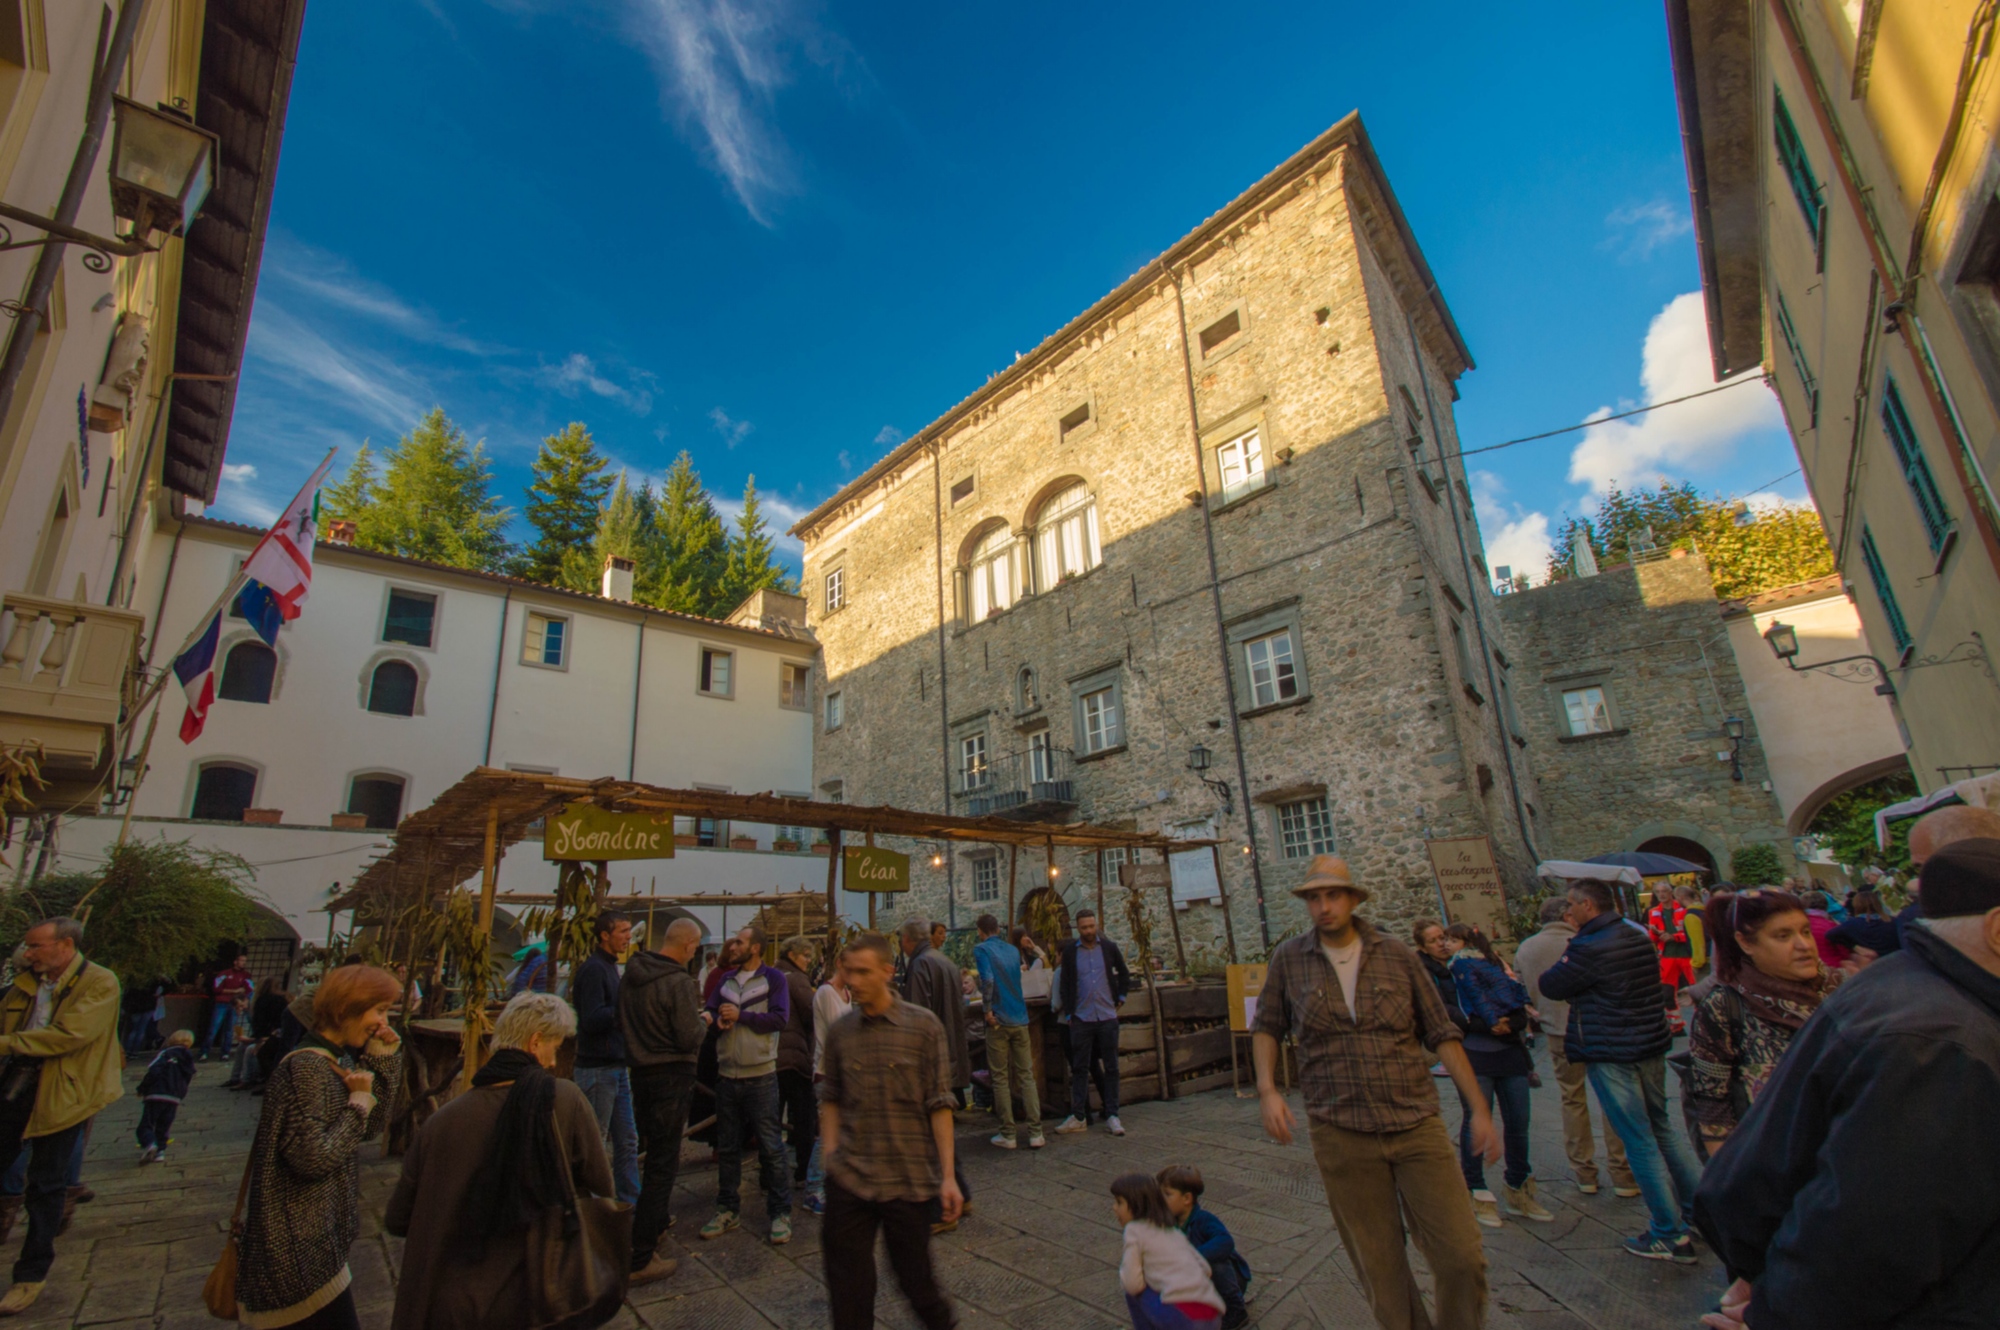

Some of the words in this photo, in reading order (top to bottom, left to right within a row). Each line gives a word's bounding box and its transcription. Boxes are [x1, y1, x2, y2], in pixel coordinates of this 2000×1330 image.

[554, 818, 660, 854] Mondine
[859, 856, 898, 880] Cian
[1440, 866, 1494, 879] castagna
[1444, 880, 1498, 891] racconta
